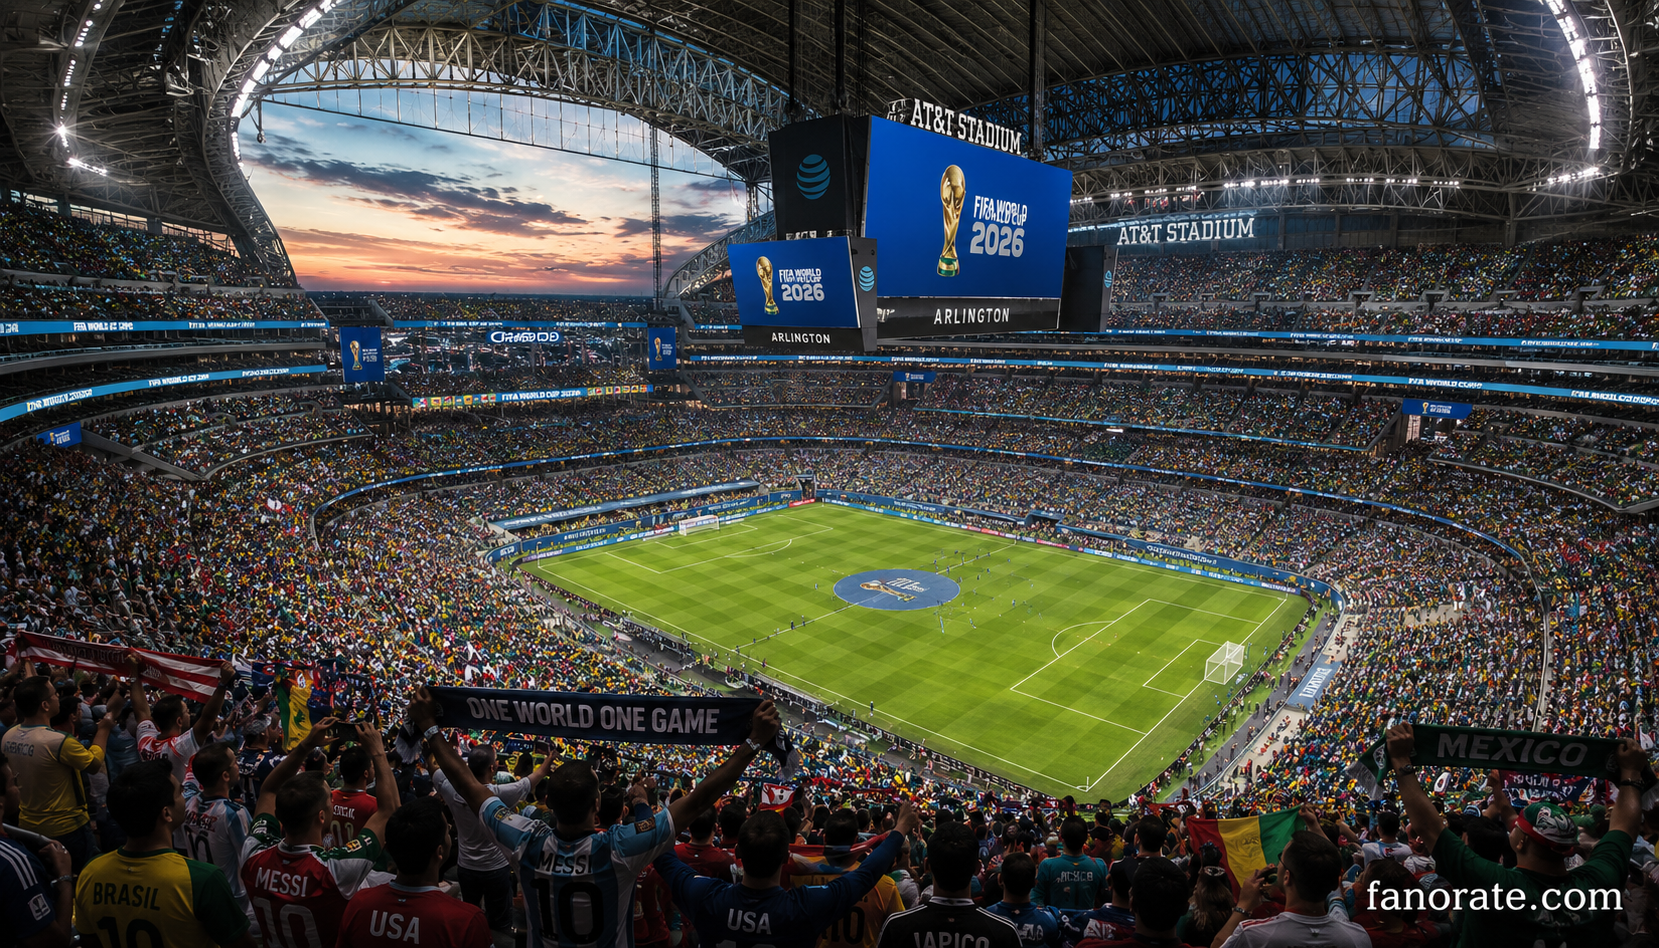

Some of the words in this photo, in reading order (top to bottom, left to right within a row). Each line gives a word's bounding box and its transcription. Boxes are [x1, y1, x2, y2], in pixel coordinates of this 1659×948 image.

[910, 98, 955, 136] AT&T
[958, 113, 1021, 155] STADIUM
[970, 221, 1025, 257] 2026
[1117, 223, 1162, 245] AT&T
[1166, 217, 1255, 242] STADIUM
[781, 283, 825, 301] 2026
[934, 307, 1010, 325] ARLINGTON
[771, 332, 831, 344] ARLINGTON
[466, 697, 513, 723] ONE
[513, 700, 594, 729] WORLD
[600, 705, 646, 732] ONE
[651, 707, 720, 734] GAME
[1436, 733, 1588, 767] MEXICO
[537, 850, 593, 875] MESSI
[92, 882, 161, 911] BRASIL
[255, 866, 309, 898] MESSI
[530, 878, 604, 945] 10
[727, 908, 772, 935] USA
[369, 909, 421, 945] USA
